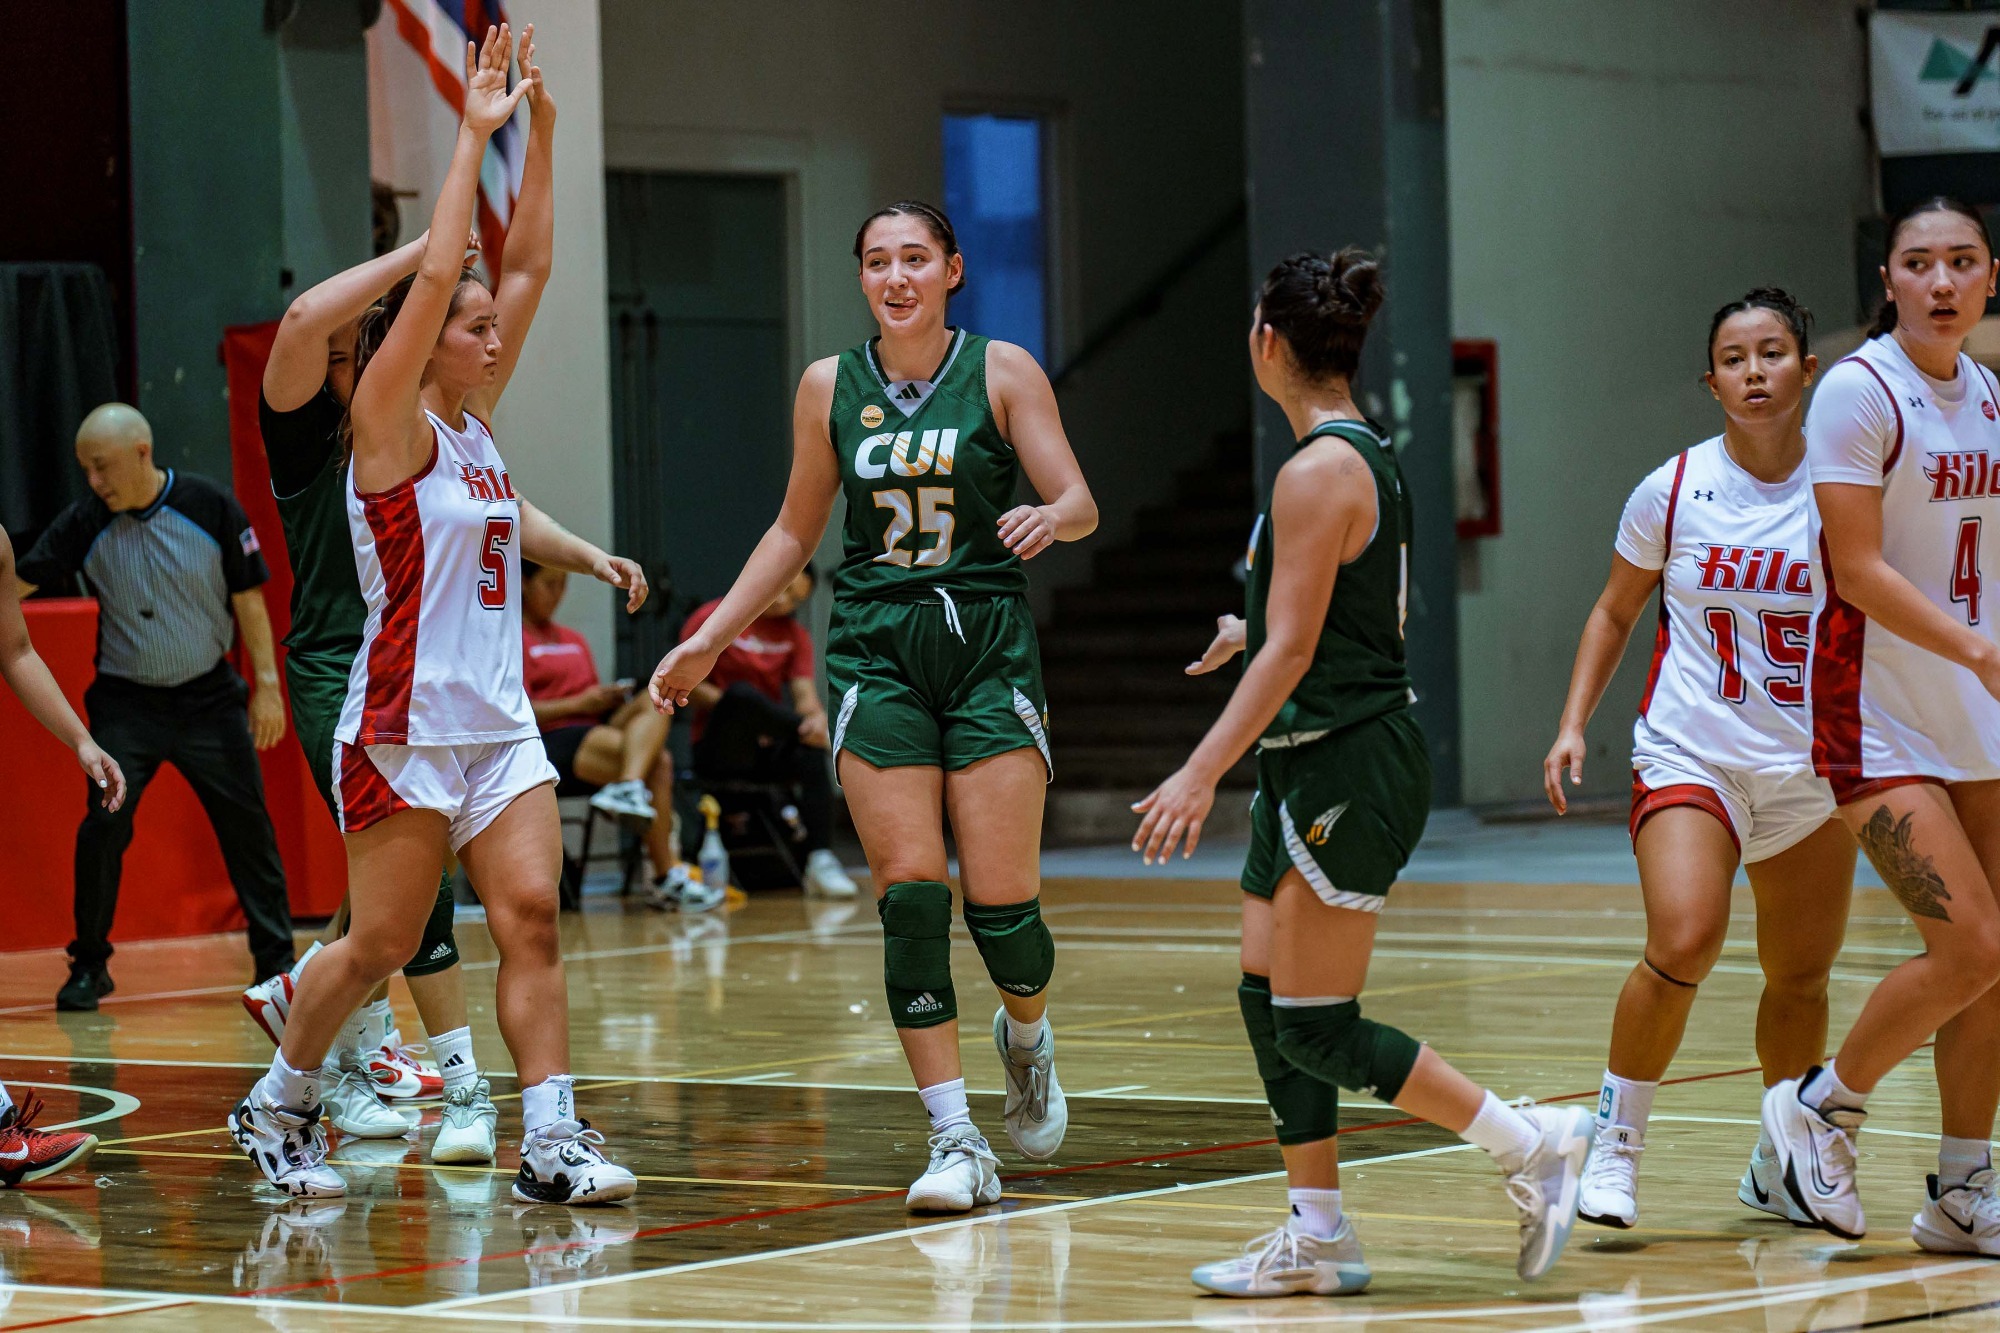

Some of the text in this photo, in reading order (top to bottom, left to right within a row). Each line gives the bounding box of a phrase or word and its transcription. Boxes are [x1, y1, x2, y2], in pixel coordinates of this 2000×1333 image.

[854, 428, 959, 480] CUI
[477, 517, 513, 610] 5
[872, 486, 955, 568] 25
[1950, 516, 1982, 626] 4
[1704, 607, 1814, 707] 15
[907, 1001, 943, 1013] adidas
